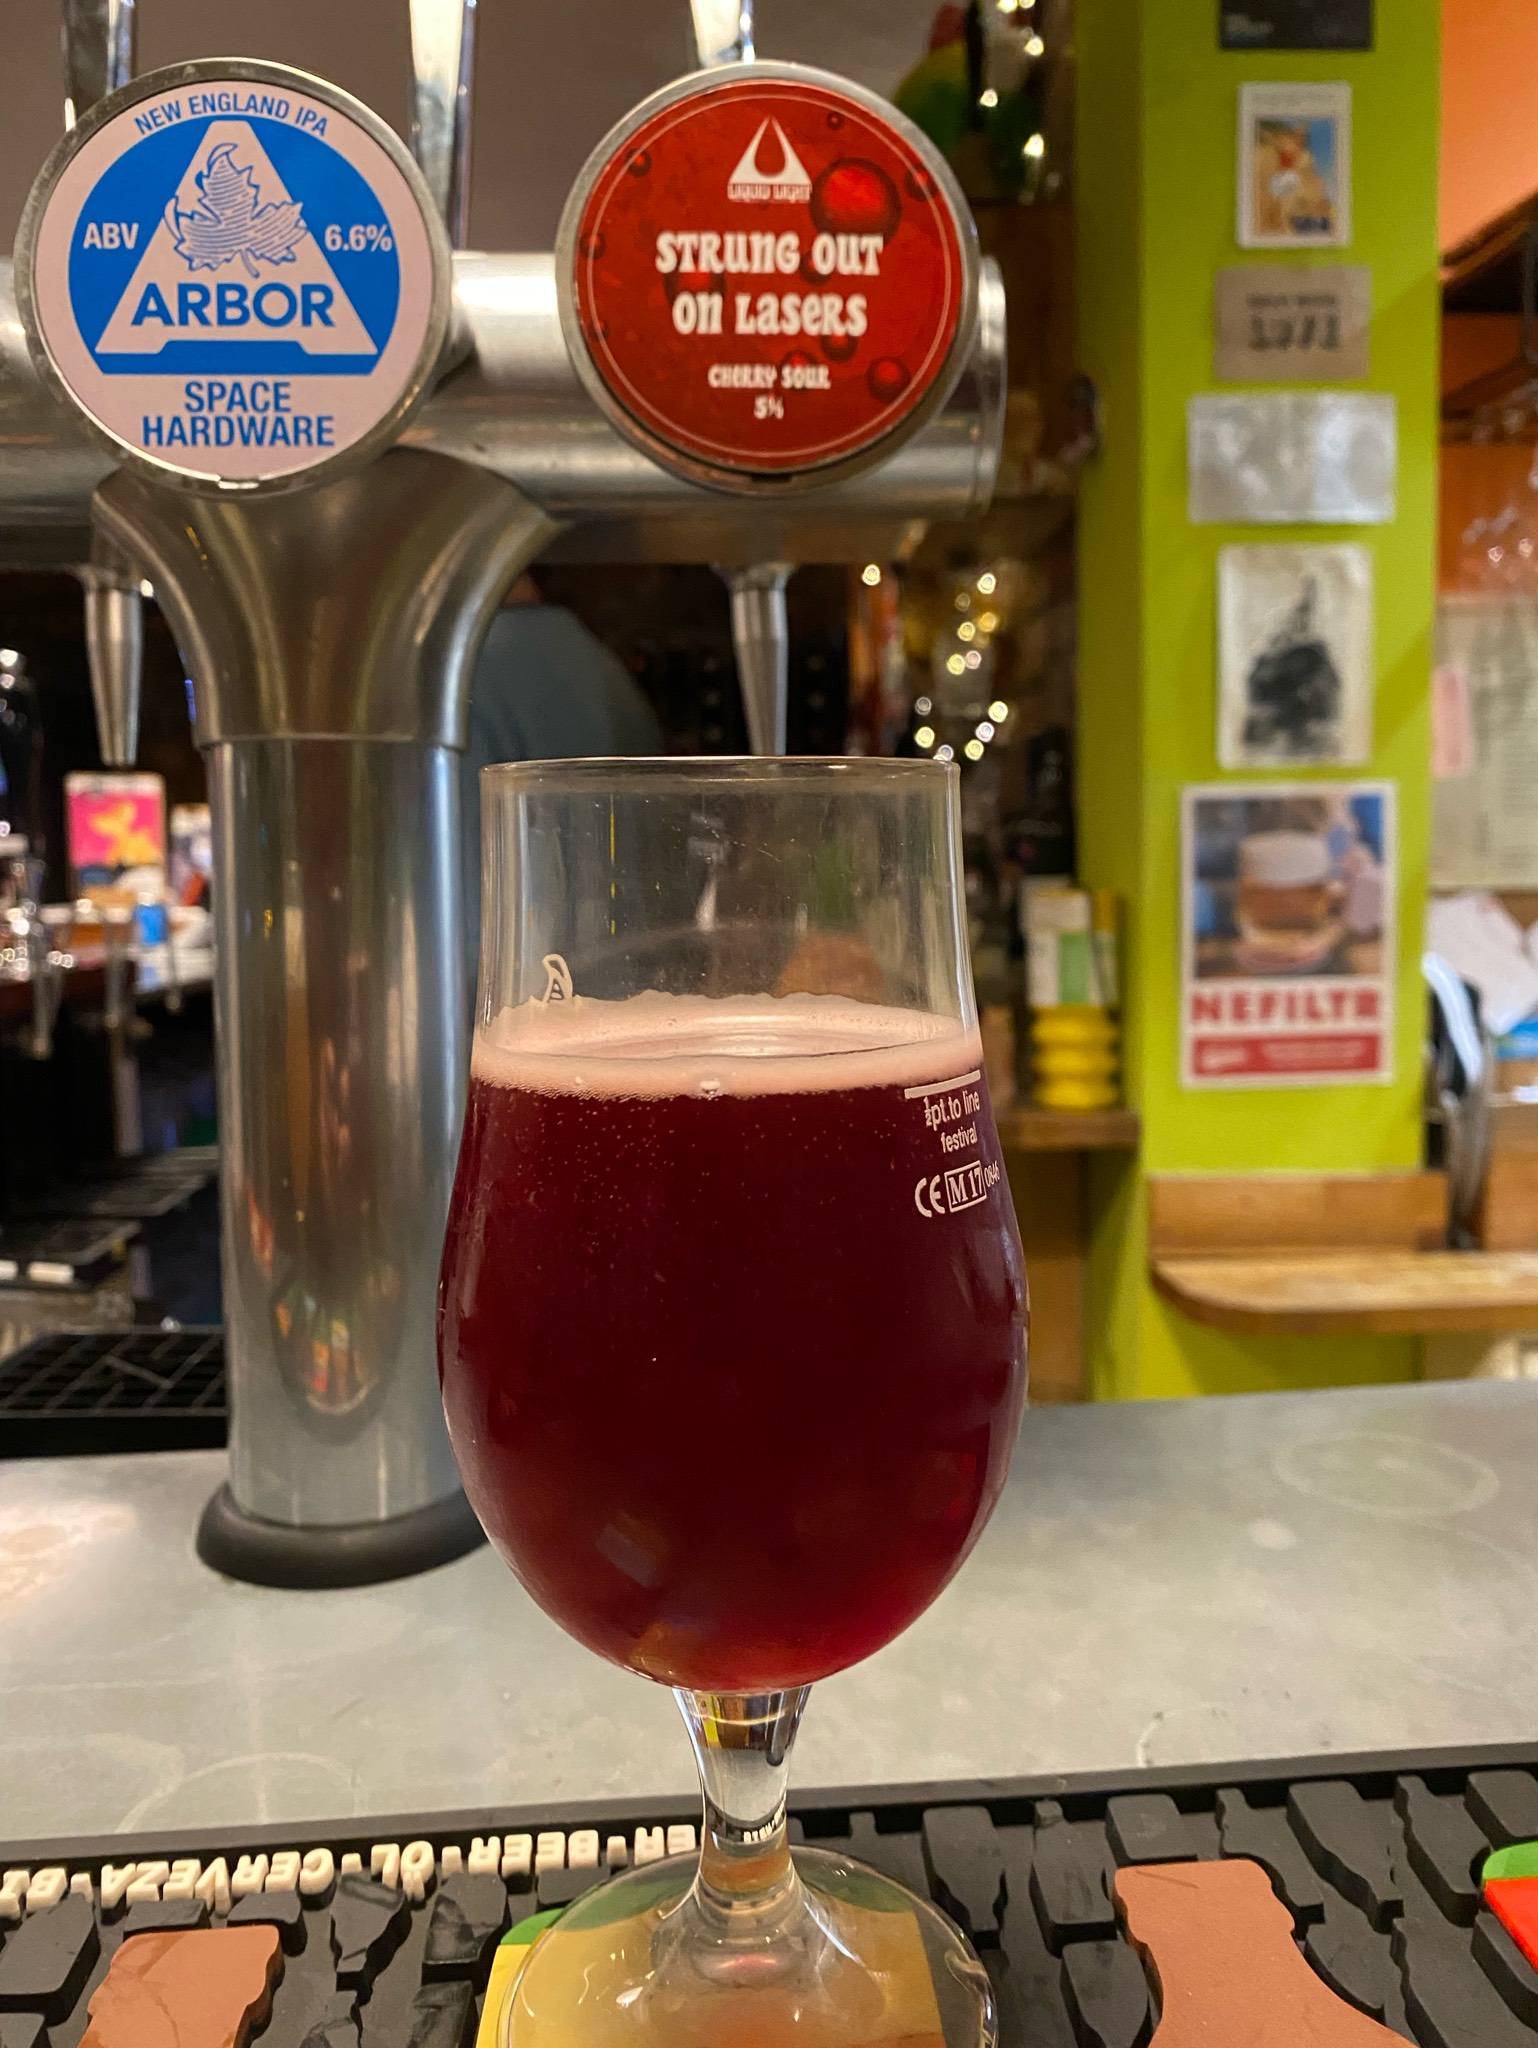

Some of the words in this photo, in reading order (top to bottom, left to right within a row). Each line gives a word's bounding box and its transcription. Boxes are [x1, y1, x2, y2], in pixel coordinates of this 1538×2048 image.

[133, 100, 182, 135] NEW
[188, 92, 290, 119] ENGLAND
[295, 106, 328, 137] IPA
[83, 222, 139, 250] ABV
[324, 224, 393, 252] 6.6%
[131, 282, 335, 328] ARBOR
[708, 363, 778, 389] CHERRY
[781, 364, 832, 390] SOUR
[184, 380, 292, 413] SPACE
[142, 416, 335, 447] HARDWARE
[962, 1089, 981, 1115] line
[940, 1121, 978, 1153] festival
[468, 1829, 599, 1878] BEER
[101, 1848, 334, 1915] CERVEZA
